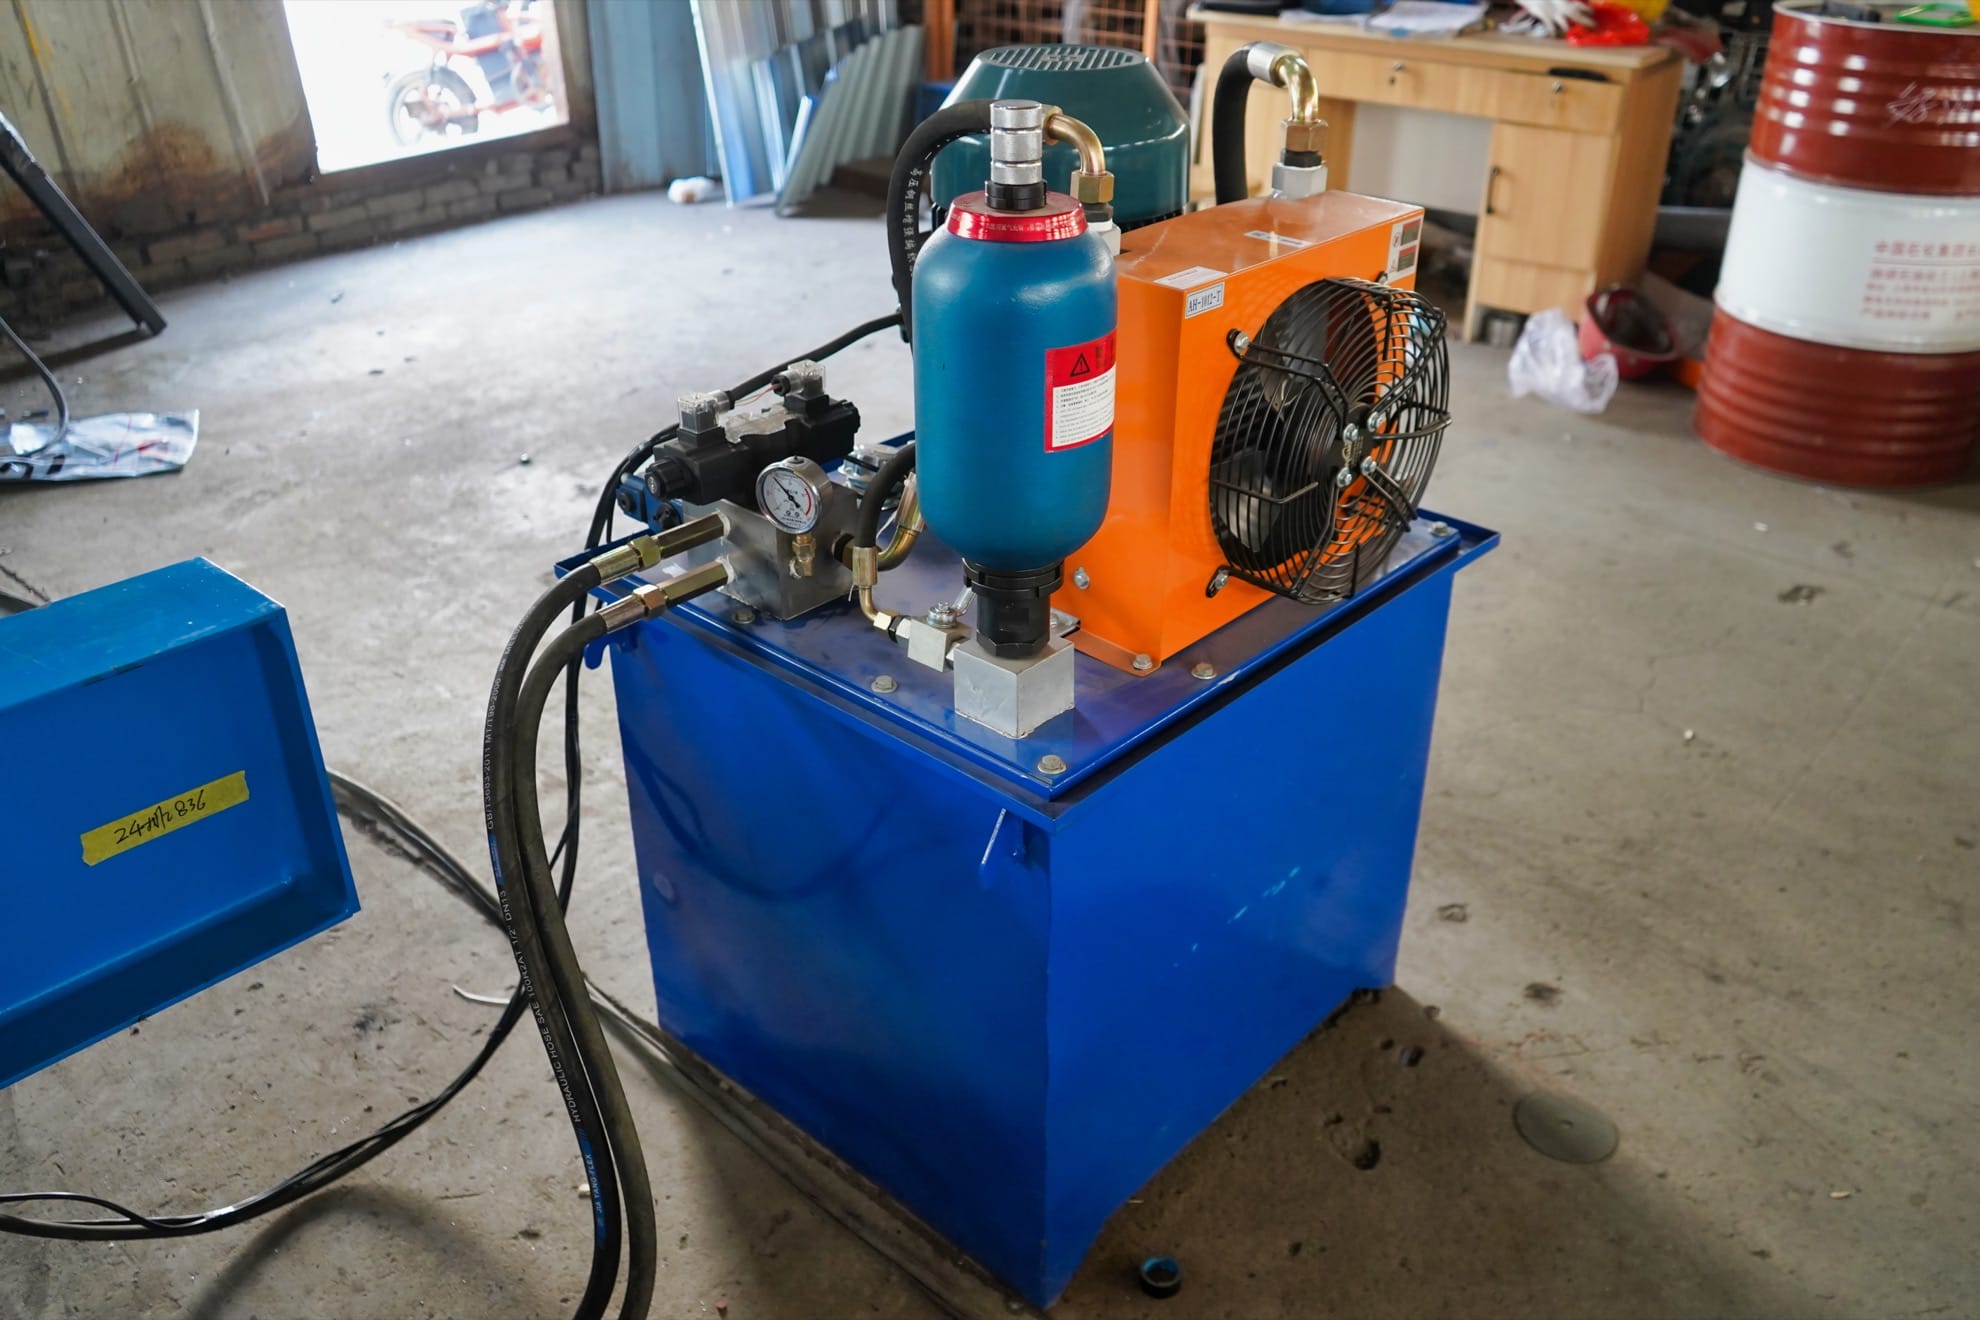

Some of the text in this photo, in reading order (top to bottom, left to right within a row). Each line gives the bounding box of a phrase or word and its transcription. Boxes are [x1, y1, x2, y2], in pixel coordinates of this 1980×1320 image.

[500, 890, 512, 921] DN13
[515, 951, 536, 998] 100R2AT
[531, 1002, 545, 1024] SAE
[541, 1027, 558, 1058] HOSE
[553, 1060, 581, 1122] HYDRAULIC
